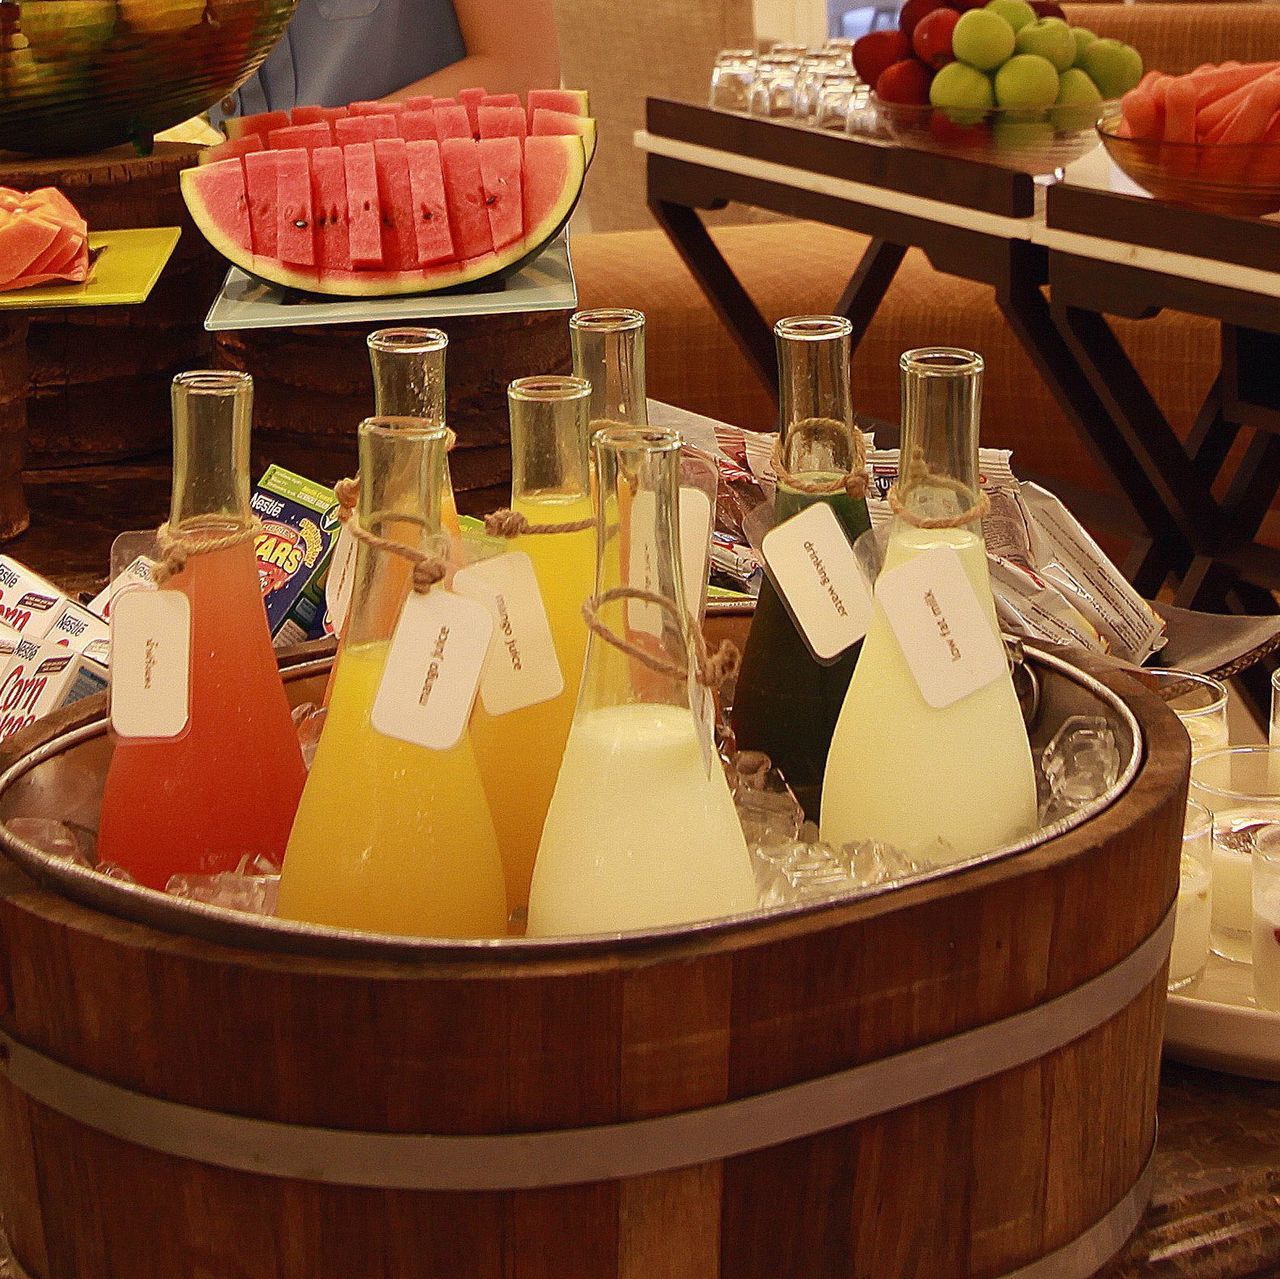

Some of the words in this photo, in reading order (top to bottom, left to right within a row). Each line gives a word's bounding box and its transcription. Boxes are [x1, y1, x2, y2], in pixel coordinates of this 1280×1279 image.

[249, 491, 286, 518] Nestlé
[254, 533, 302, 575] TARS
[803, 541, 830, 587] drinking
[828, 585, 849, 617] water
[55, 612, 89, 638] Nestlé
[936, 617, 951, 637] fat
[504, 639, 522, 671] juice
[945, 639, 962, 663] low
[419, 661, 440, 707] mango
[431, 625, 451, 661] juice
